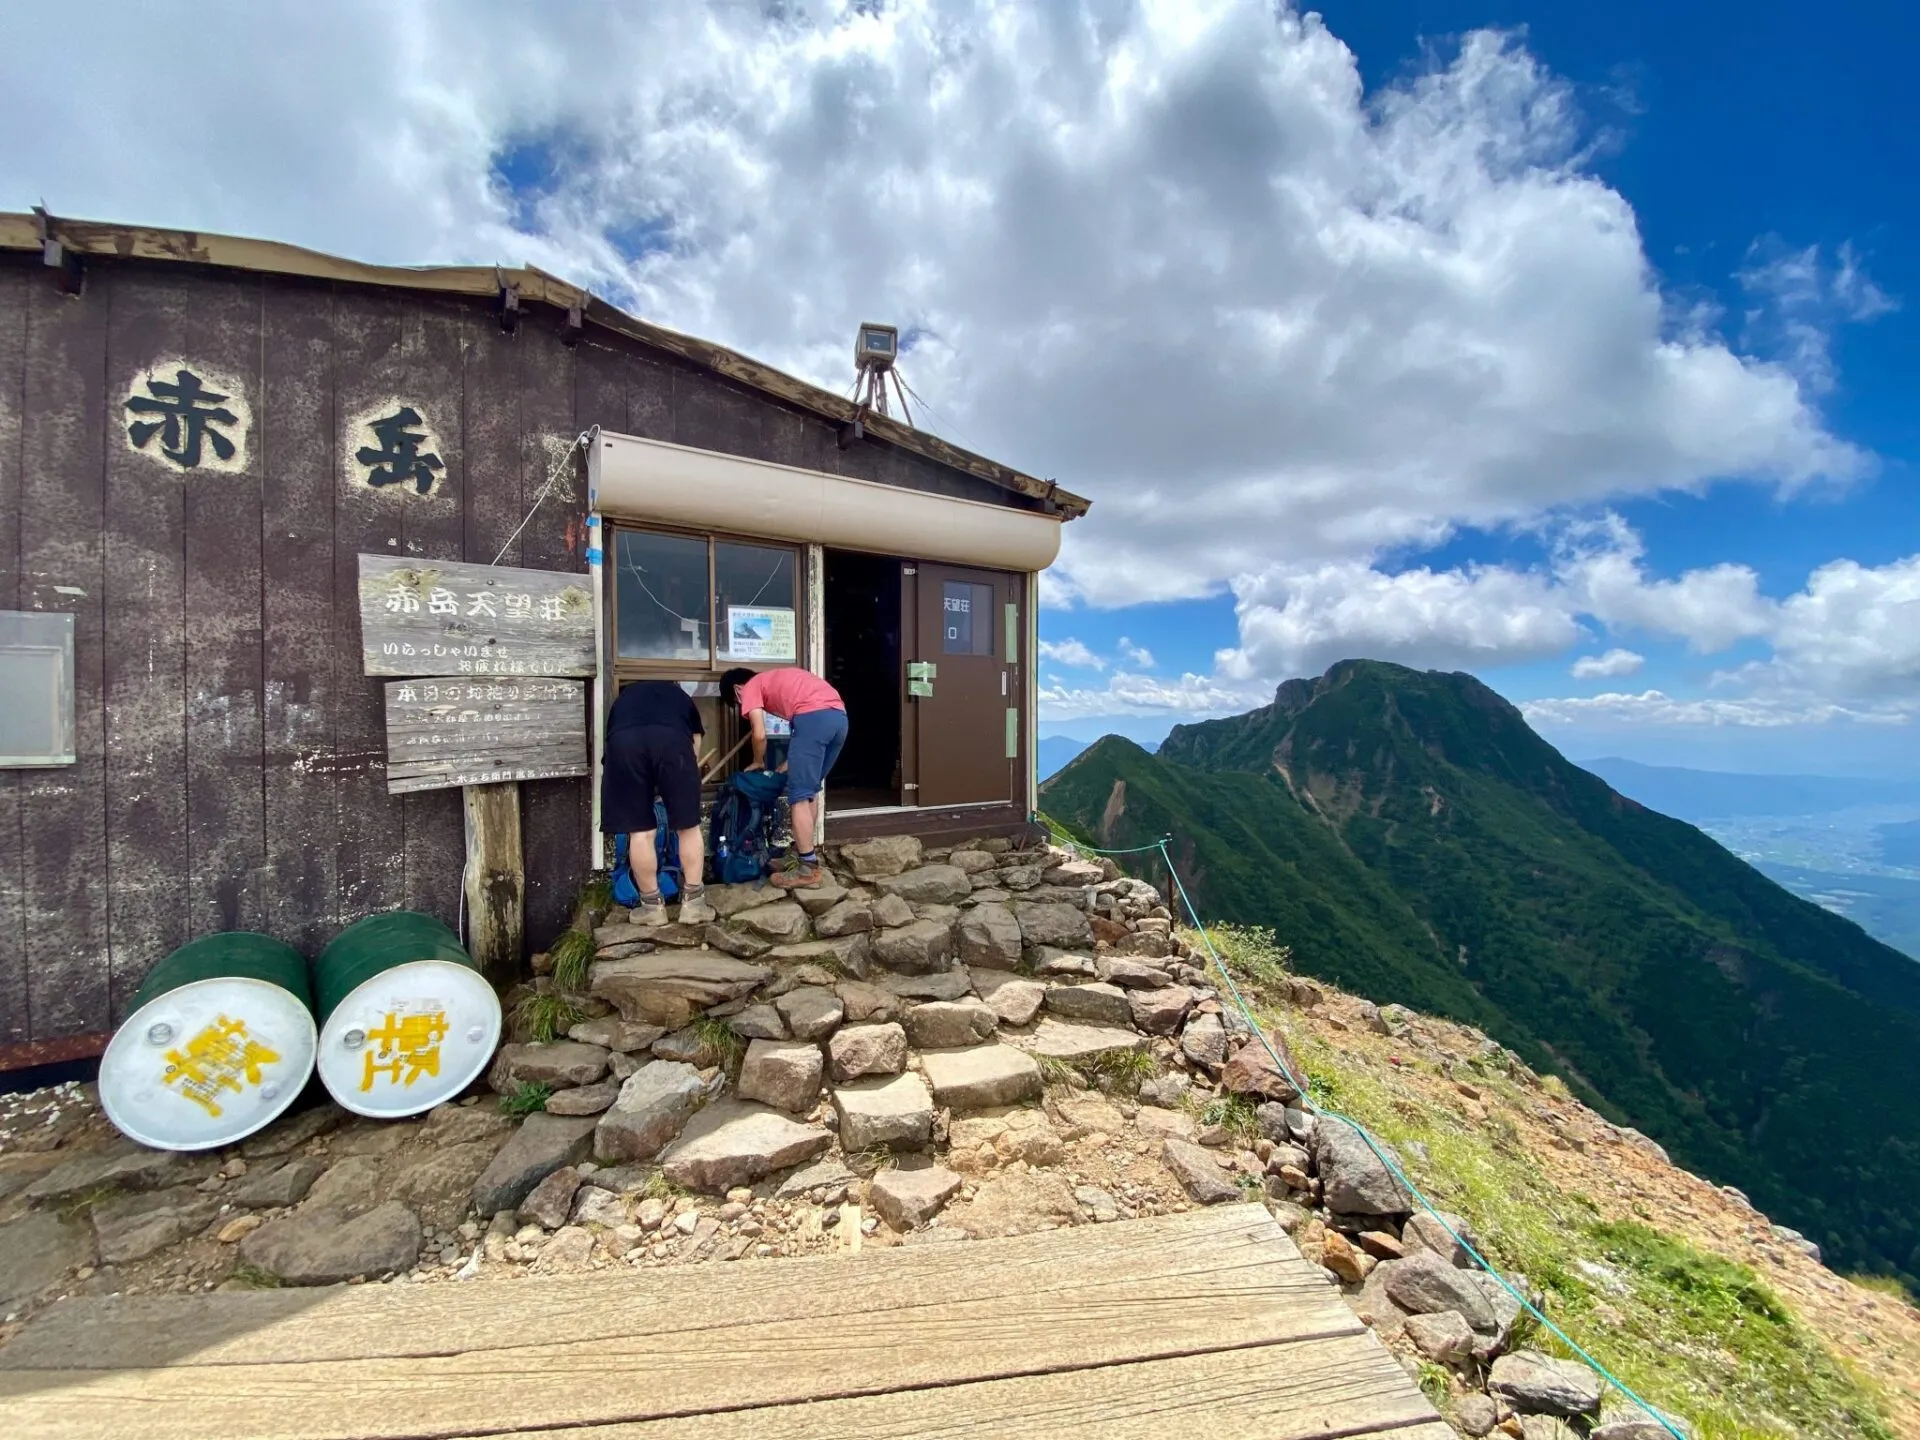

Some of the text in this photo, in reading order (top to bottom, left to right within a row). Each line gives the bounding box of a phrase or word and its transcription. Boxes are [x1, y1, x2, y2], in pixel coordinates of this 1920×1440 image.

[385, 584, 569, 621] 赤岳天望荘
[383, 642, 509, 658] いらっしゃいませ
[457, 659, 571, 674] お疲れ様でした
